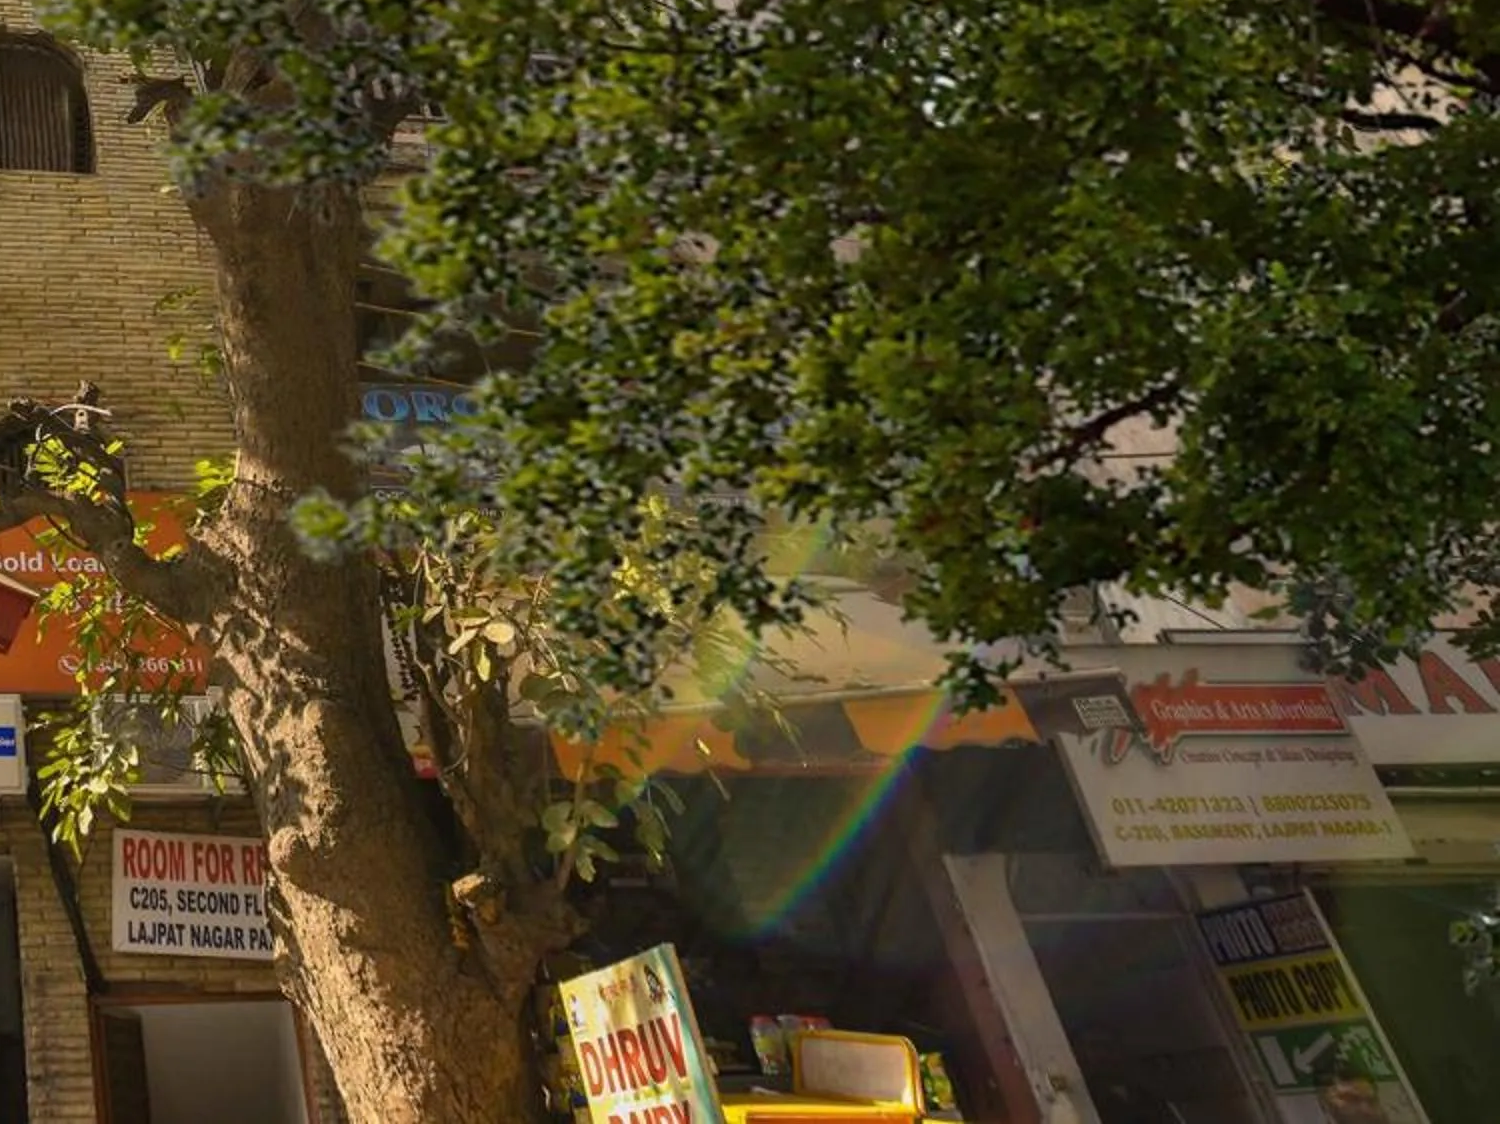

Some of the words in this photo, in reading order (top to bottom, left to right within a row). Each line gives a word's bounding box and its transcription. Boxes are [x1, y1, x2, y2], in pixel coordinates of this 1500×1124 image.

[52, 552, 107, 573] Loa
[123, 837, 186, 882] ROOM
[192, 842, 236, 886] FOR
[130, 886, 173, 916] C205,
[177, 890, 240, 916] SECOND
[244, 893, 262, 916] FL
[128, 921, 185, 946] LAJPAT
[190, 925, 245, 950] NAGAR
[249, 927, 274, 951] PA
[1227, 968, 1304, 1021] PHOTO
[580, 1012, 687, 1097] DHRUV
